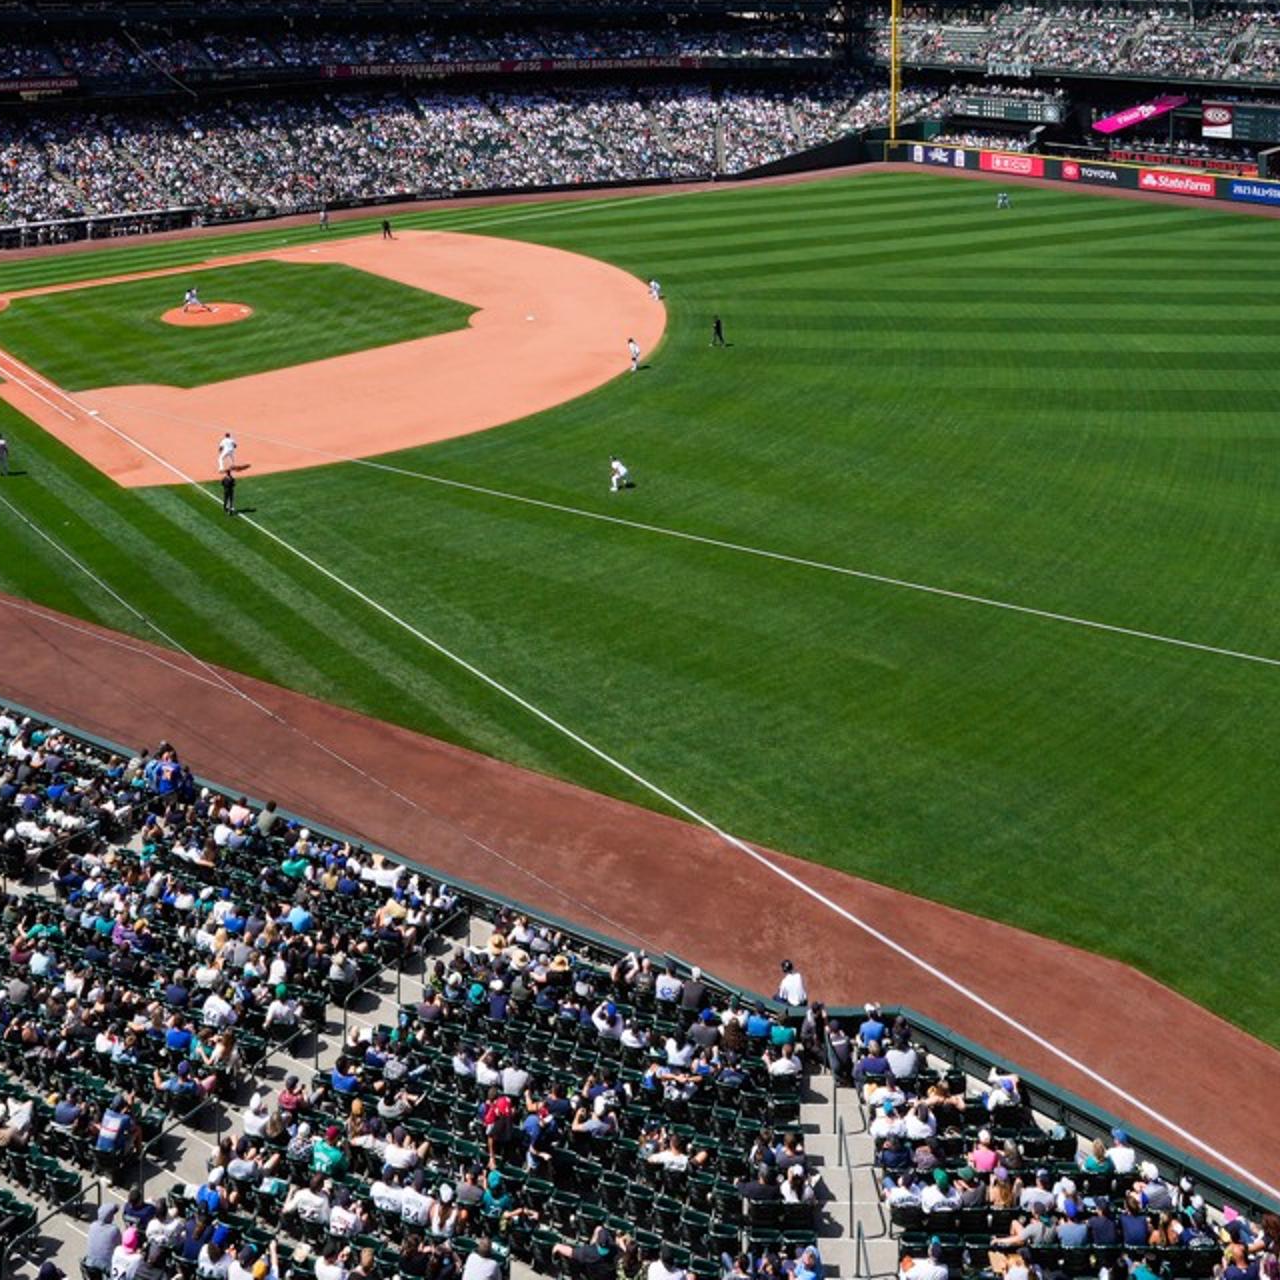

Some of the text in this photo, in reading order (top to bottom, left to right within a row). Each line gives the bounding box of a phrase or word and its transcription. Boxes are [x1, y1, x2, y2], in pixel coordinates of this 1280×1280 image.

[351, 65, 368, 75] THE
[370, 65, 392, 75] BEST
[394, 64, 446, 75] COVERAGE
[456, 63, 473, 72] THE
[475, 61, 501, 71] GAME
[1080, 168, 1117, 180] TOYOTA
